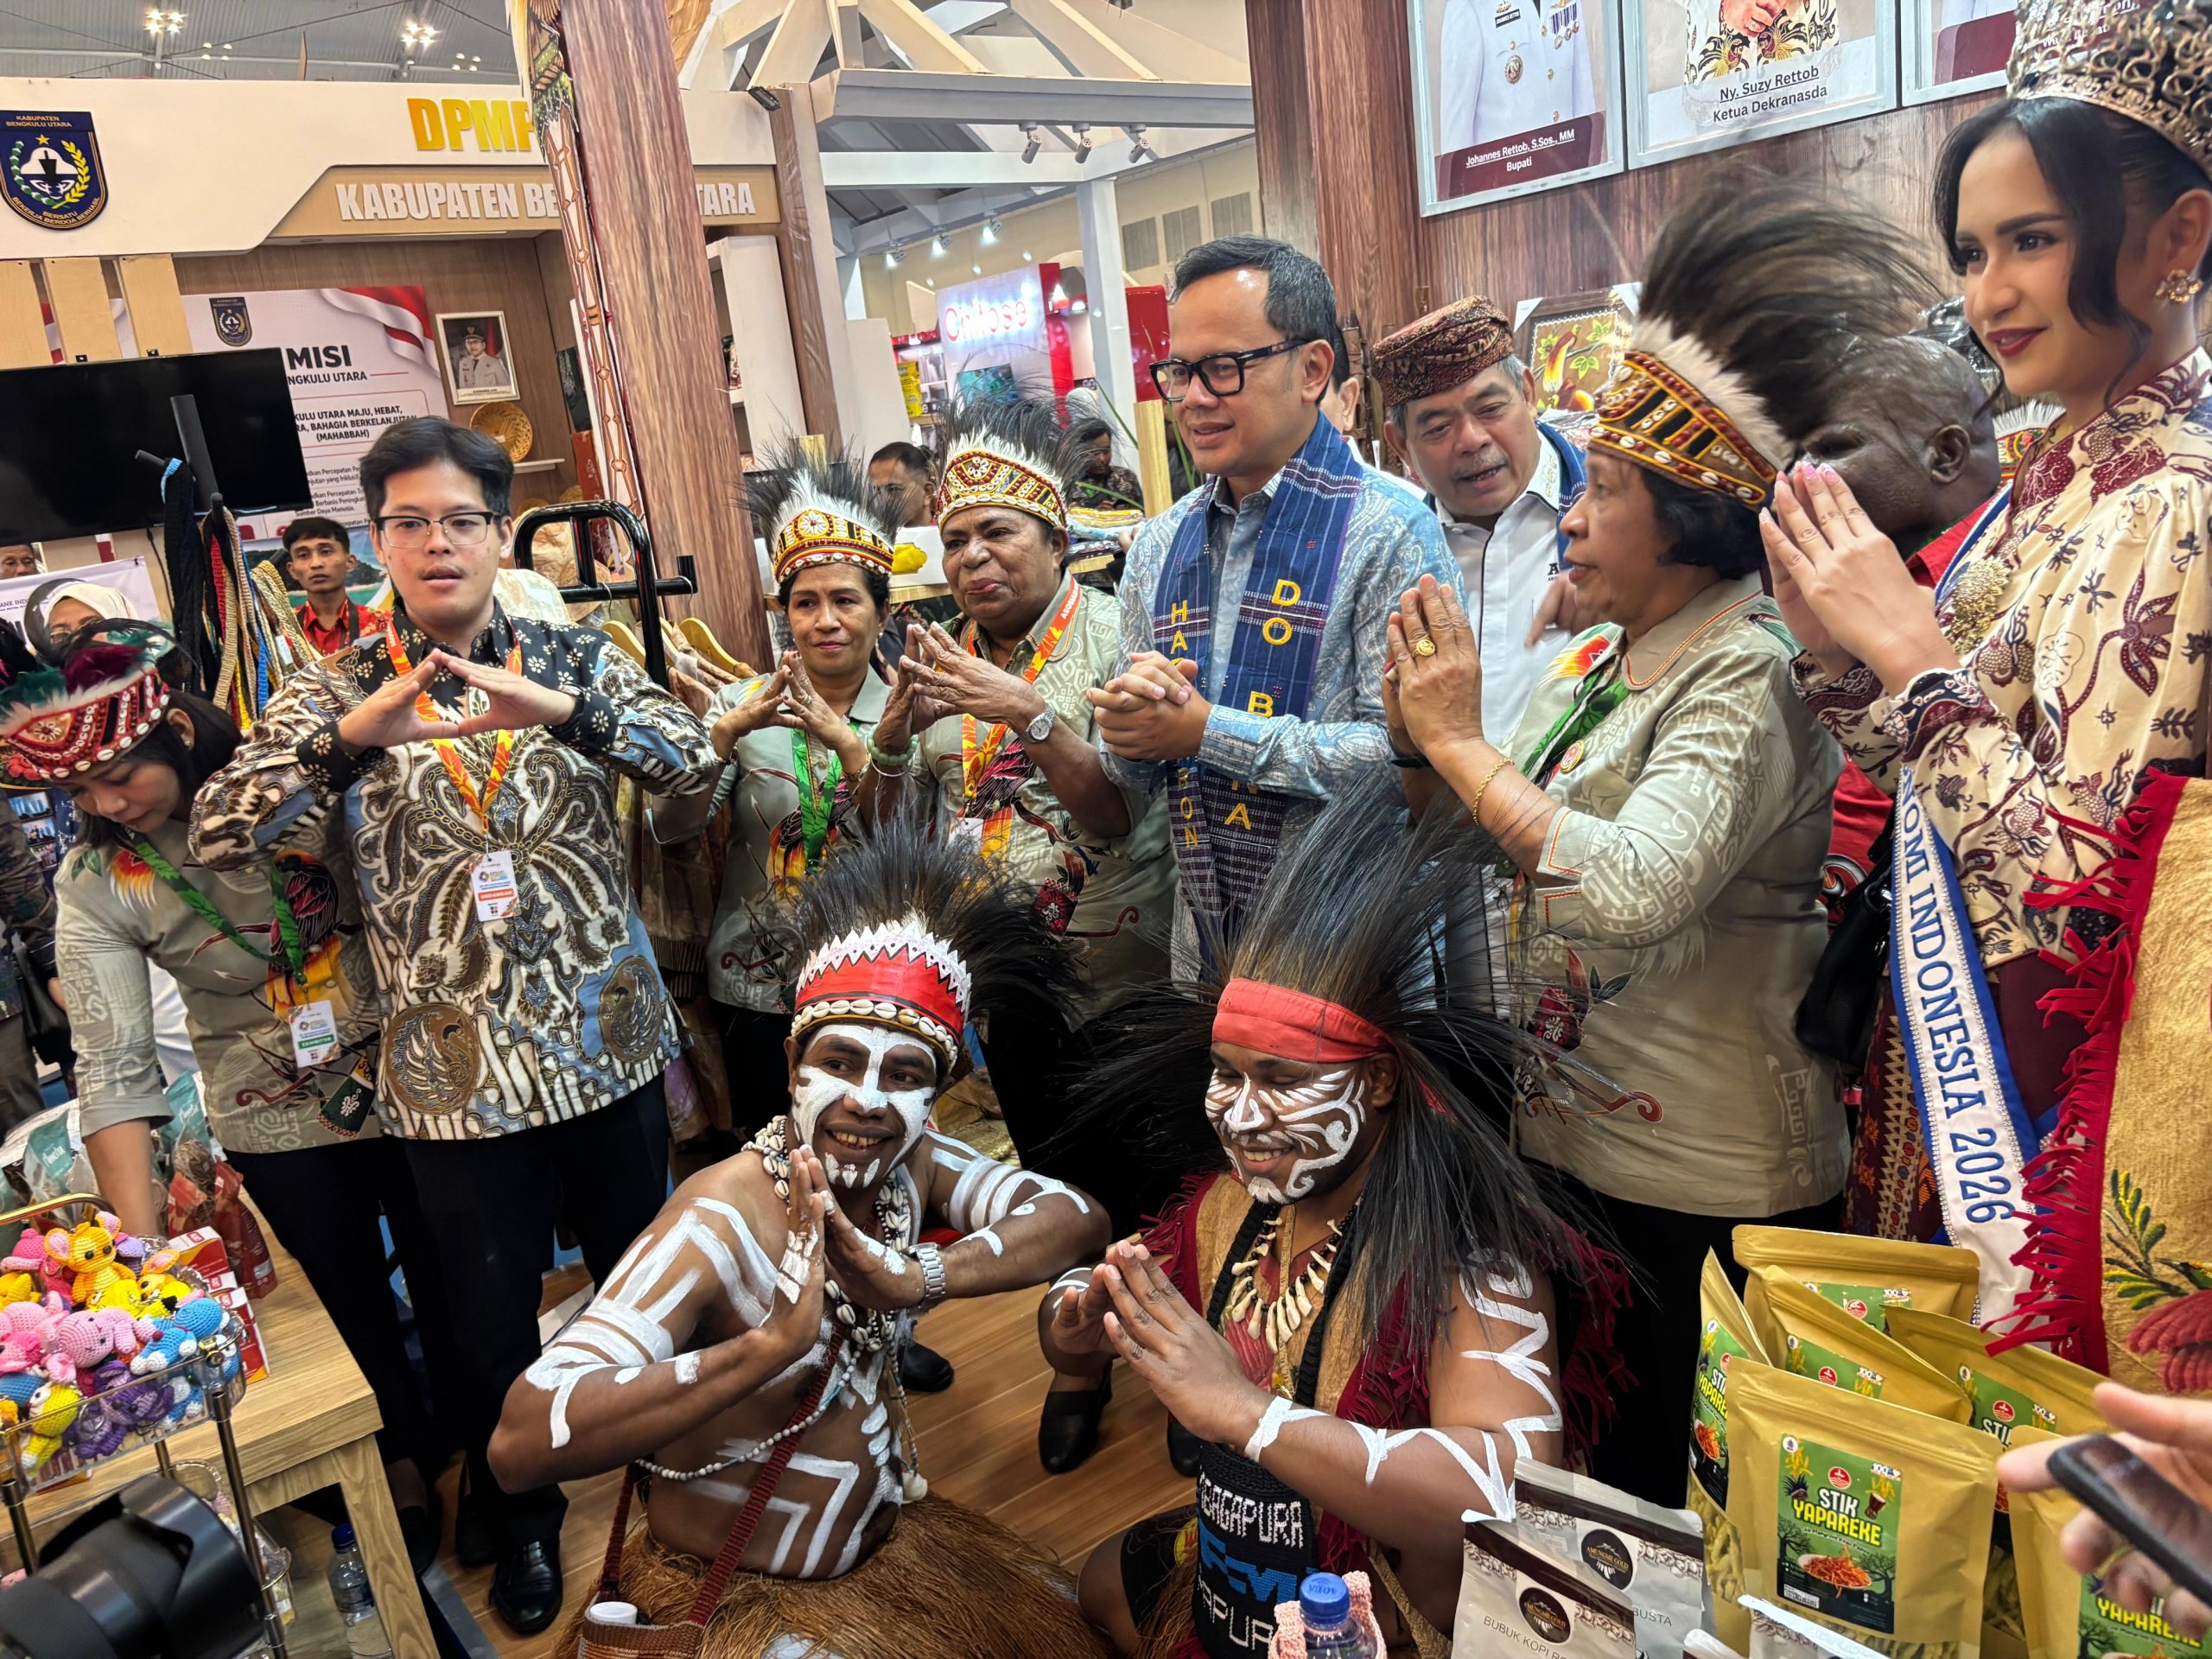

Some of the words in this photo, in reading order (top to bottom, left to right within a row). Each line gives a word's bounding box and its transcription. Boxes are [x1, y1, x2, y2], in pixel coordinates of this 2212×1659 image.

[1719, 87, 1739, 101] Ny.
[1742, 78, 1772, 95] Suzy
[1775, 65, 1819, 87] Rettob
[1713, 105, 1748, 122] Ketua
[1751, 85, 1827, 113] Dekranasda
[1465, 150, 1501, 166] Johannes
[1502, 141, 1530, 156] Rettob,
[1531, 135, 1558, 149] S.Sos.,
[1559, 129, 1575, 142] MM
[1506, 156, 1533, 172] Bupati
[12, 196, 43, 220] BEKERJA
[43, 217, 78, 226] BERDOA
[42, 211, 78, 219] BERSATU
[335, 181, 519, 222] KABUPATEN
[286, 345, 352, 371] MISI
[333, 371, 367, 384] UTARA
[311, 420, 348, 431] BAHAGIA
[317, 409, 346, 420] UTARA
[347, 407, 373, 417] MAJU,
[374, 405, 403, 416] HEBAT,
[316, 429, 370, 442] (MAHABBAH)
[321, 467, 352, 476] Percepatan
[1908, 893, 1987, 1121] INDONESIA
[1949, 1126, 2017, 1225] 2026
[1819, 1487, 1859, 1518] STIK
[1793, 1499, 1882, 1547] YAPAREKE
[1483, 1614, 1522, 1645] BUBUK
[1522, 1637, 1550, 1659] KOPI
